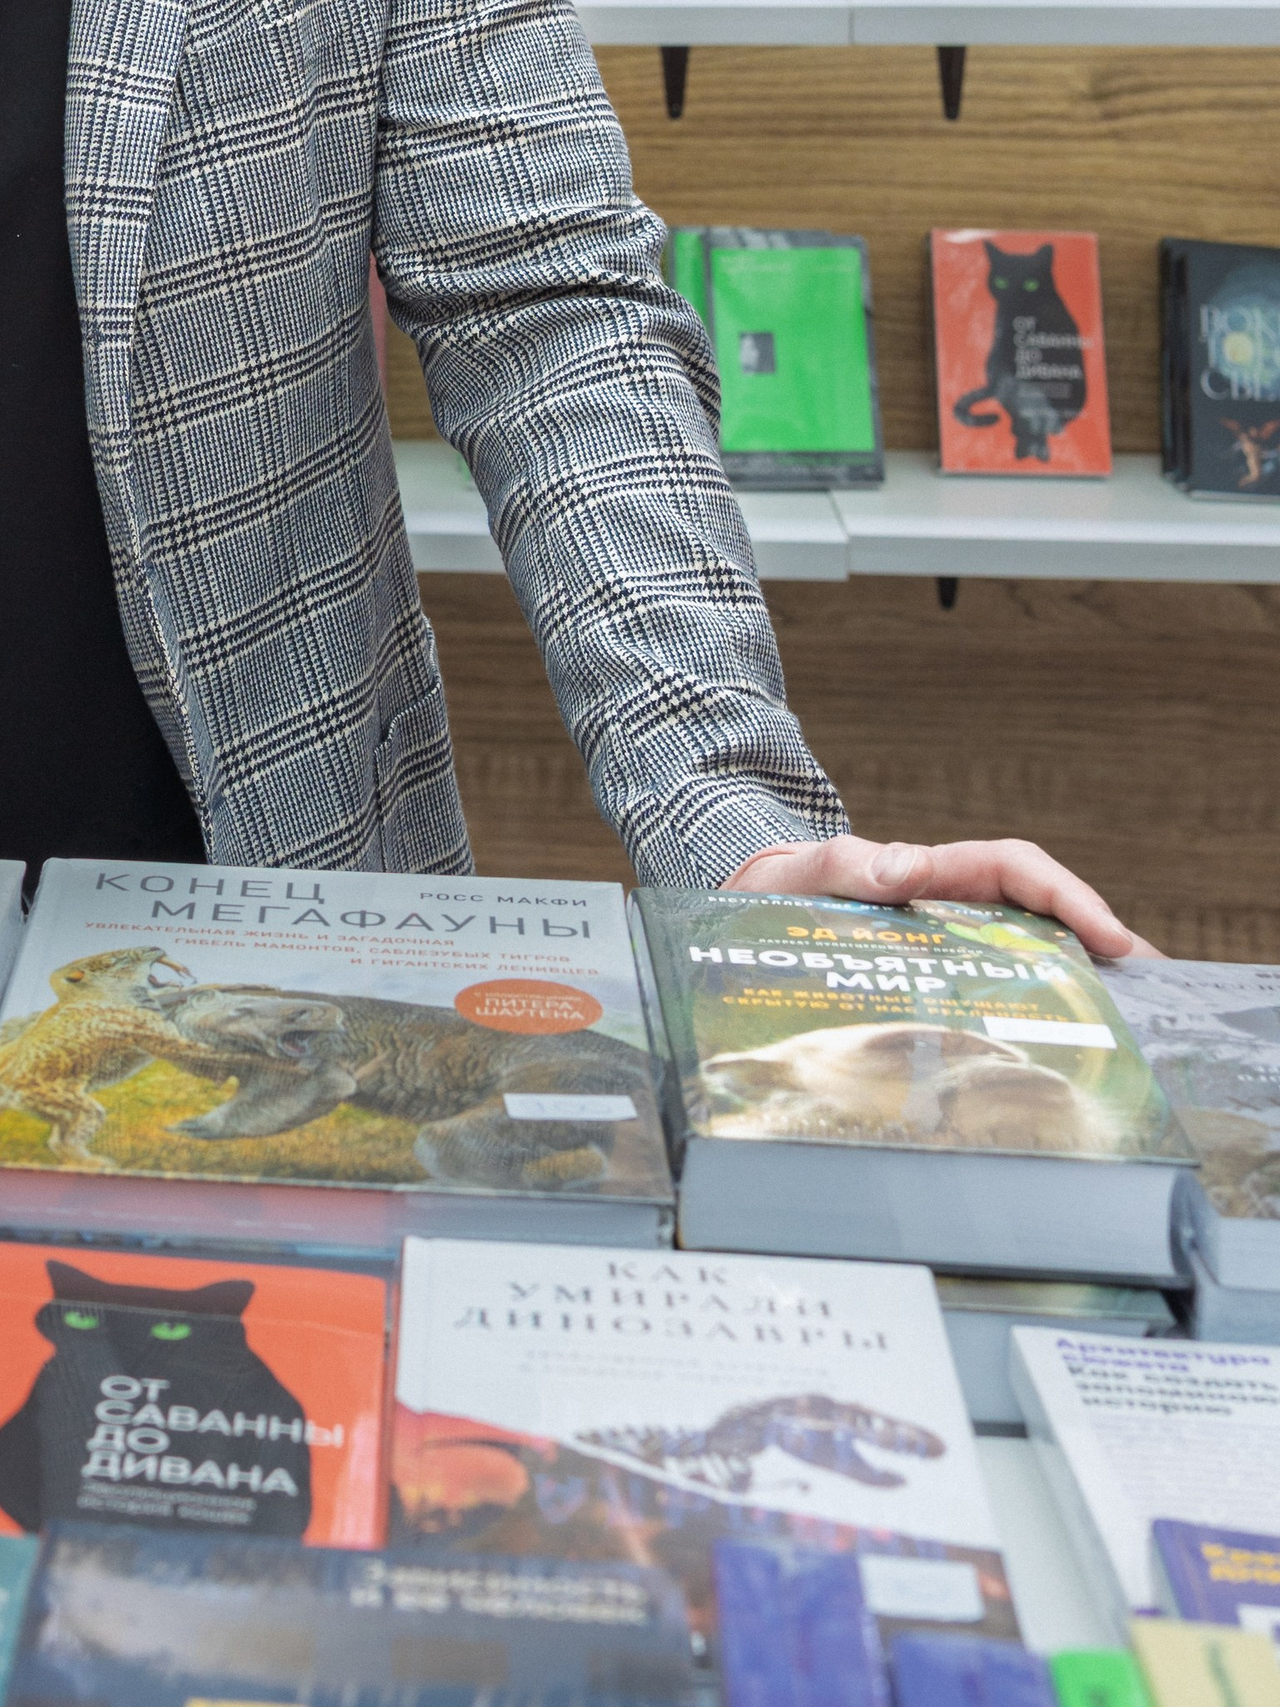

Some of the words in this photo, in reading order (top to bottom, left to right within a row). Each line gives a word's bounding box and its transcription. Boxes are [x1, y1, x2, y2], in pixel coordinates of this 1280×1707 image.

[95, 872, 325, 905] КОНЕЦ
[420, 892, 484, 903] РОСС
[497, 895, 588, 908] МАКФИ
[151, 899, 591, 939] МЕГАФАУНЫ
[84, 921, 236, 936] УВЛЕКАТЕЛЬНАЯ
[243, 930, 310, 941] ЖИЗНЬ
[338, 934, 455, 947] ЗАГАДОЧНАЯ
[786, 926, 838, 941] ЭД
[852, 927, 947, 945] ЙОНГ
[174, 937, 246, 948] ГИБЕЛЬ
[254, 941, 362, 954] МАМОНТОВ,
[369, 947, 491, 960] САБЛЕЗУБЫХ
[499, 952, 571, 963] ТИГРОВ
[371, 958, 489, 971] ГИГАНТСКИХ
[496, 963, 599, 976] ЛЕНИВЦЕВ
[689, 946, 1070, 982] НЕОБЪЯТНЫЙ
[826, 972, 947, 993] МИР
[484, 997, 574, 1012] ПИТЕРА
[723, 996, 830, 1009] СКРЫТУЮ
[839, 1002, 864, 1011] ОТ
[875, 1004, 916, 1014] НАС
[743, 988, 782, 997] КАК
[793, 990, 913, 1005] ЖИВОТНЫЕ
[475, 1006, 586, 1021] ШАУТЕНА
[607, 1261, 727, 1285] КАК
[508, 1280, 832, 1318] УМИРАЛИ
[454, 1306, 888, 1351] ДИНОЗАВРЫ
[100, 1374, 170, 1403] ОТ
[95, 1399, 345, 1449] САВАННЫ
[86, 1424, 170, 1454] ДО
[81, 1450, 300, 1497] ДИВАНА
